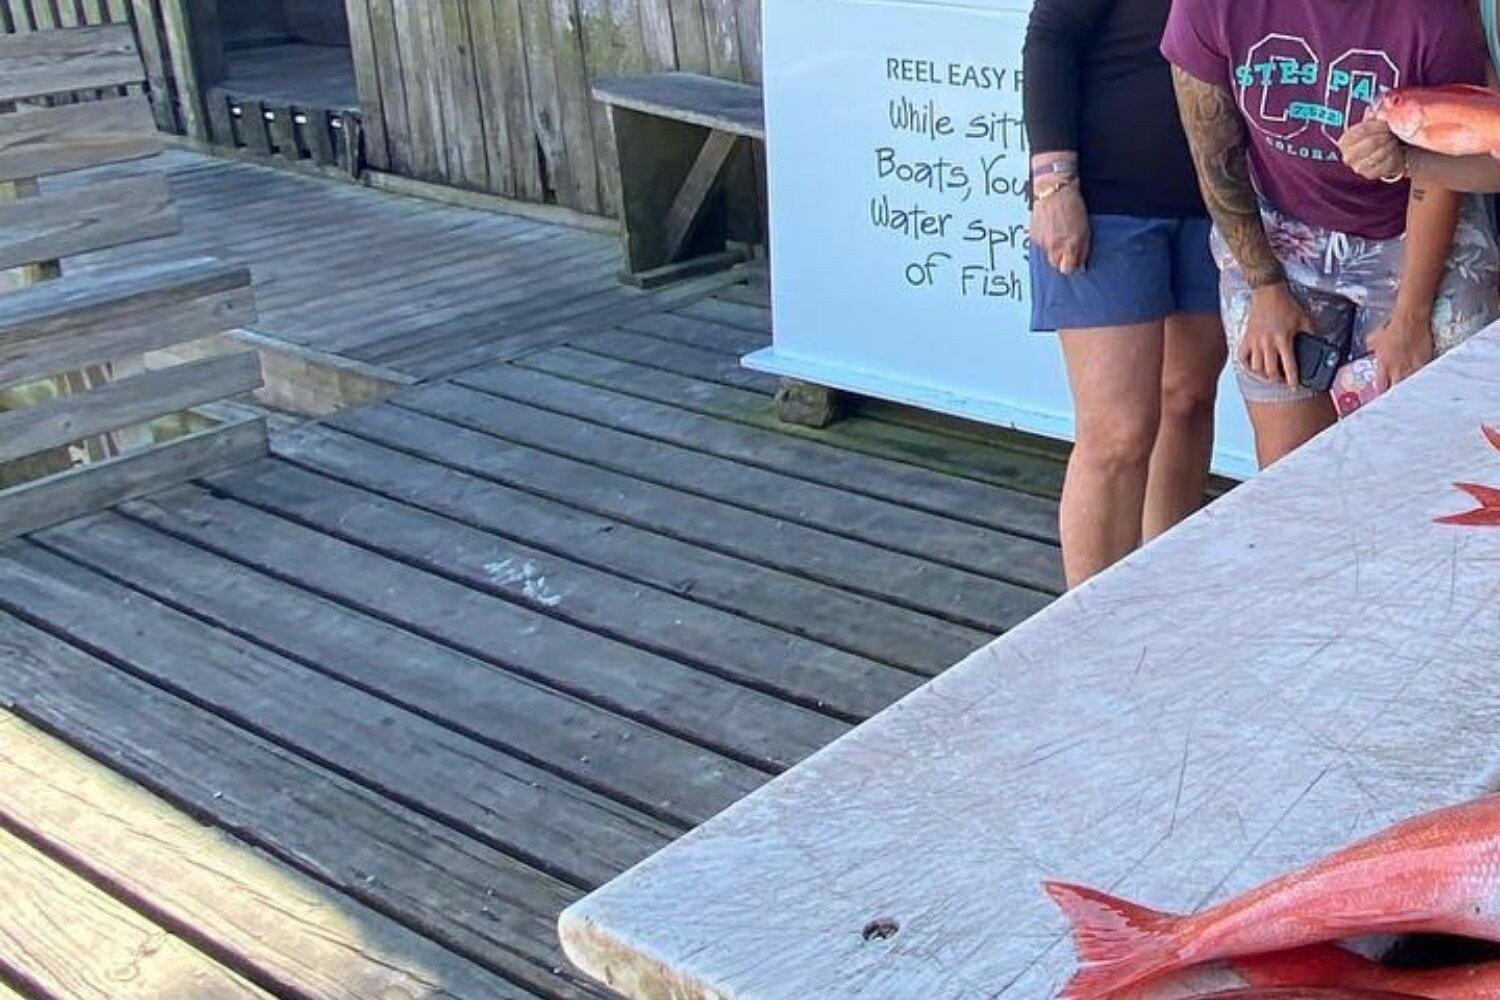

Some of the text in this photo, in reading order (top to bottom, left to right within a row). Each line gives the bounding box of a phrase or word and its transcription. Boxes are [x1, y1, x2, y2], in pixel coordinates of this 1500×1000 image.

[886, 57, 943, 85] REEL
[947, 62, 1006, 90] EASY
[1234, 60, 1320, 87] STES
[888, 94, 1027, 152] While sitt
[1265, 135, 1340, 162] COLORA
[874, 146, 972, 202] Boats,
[870, 193, 953, 241] Water
[905, 251, 1022, 301] of Fish
